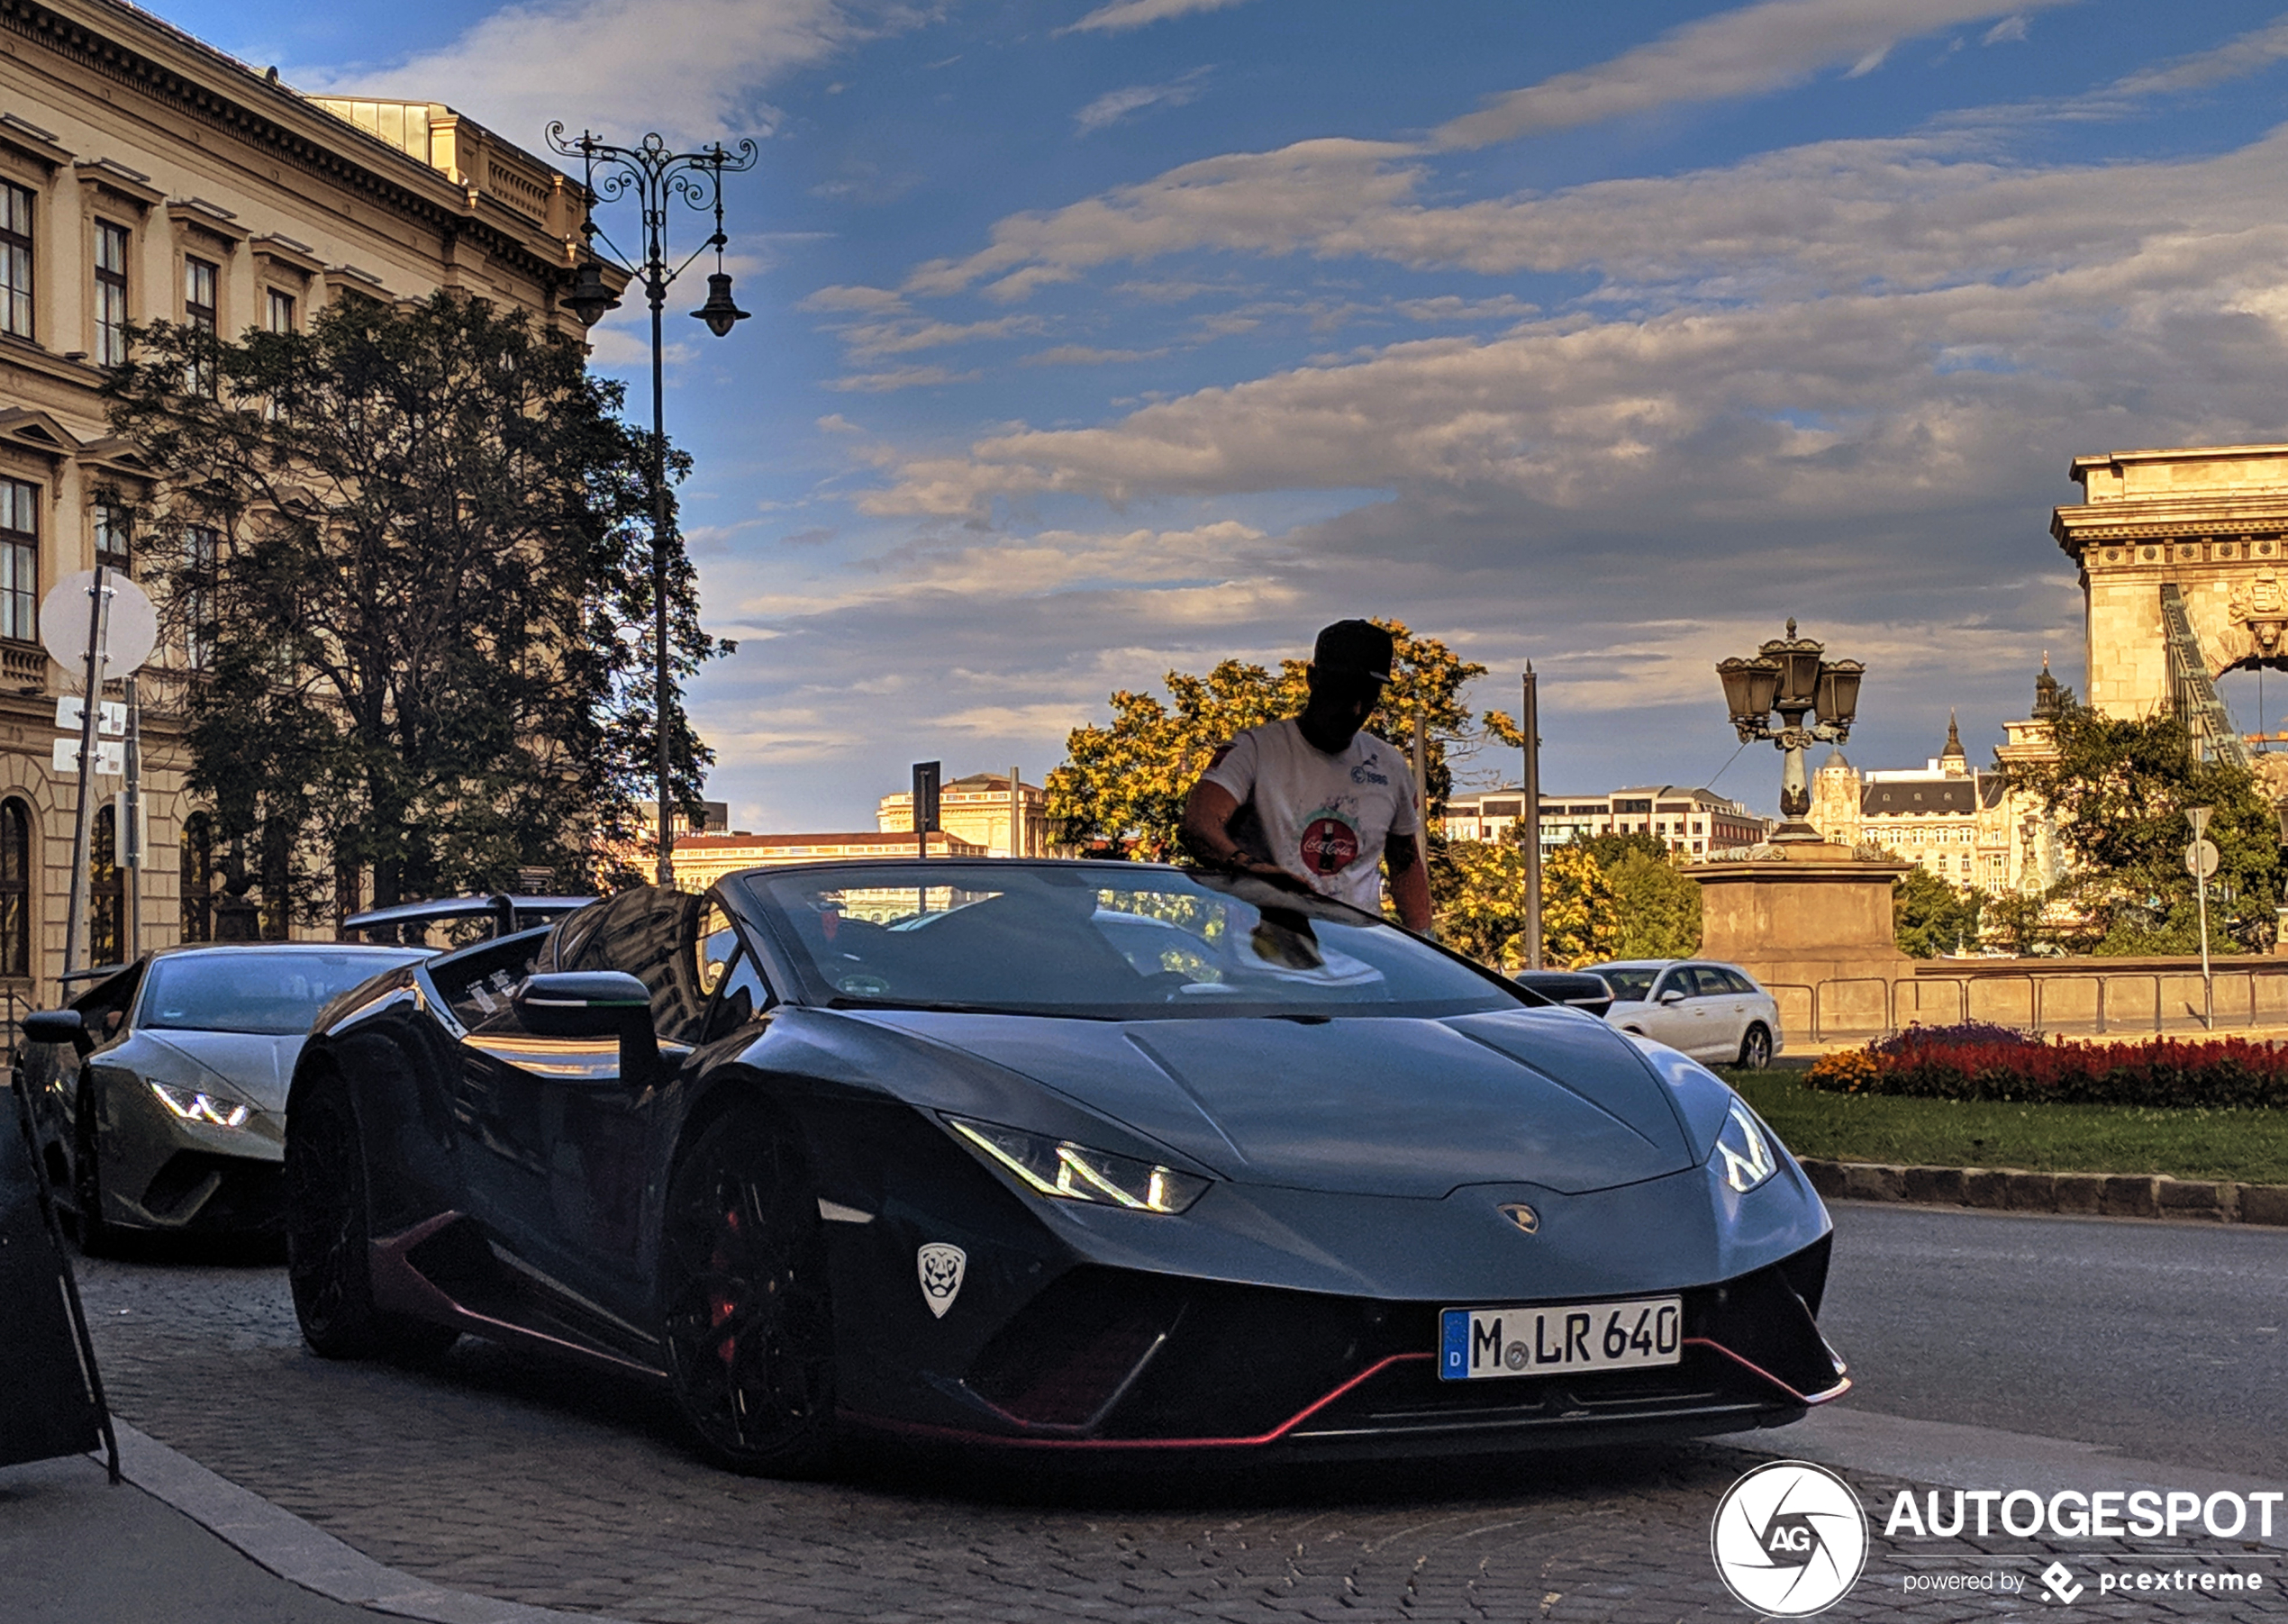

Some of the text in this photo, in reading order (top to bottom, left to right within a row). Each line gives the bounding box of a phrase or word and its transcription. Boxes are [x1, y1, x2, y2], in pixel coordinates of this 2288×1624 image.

[1473, 1305, 1677, 1368] M LR 640
[1449, 1351, 1460, 1367] D
